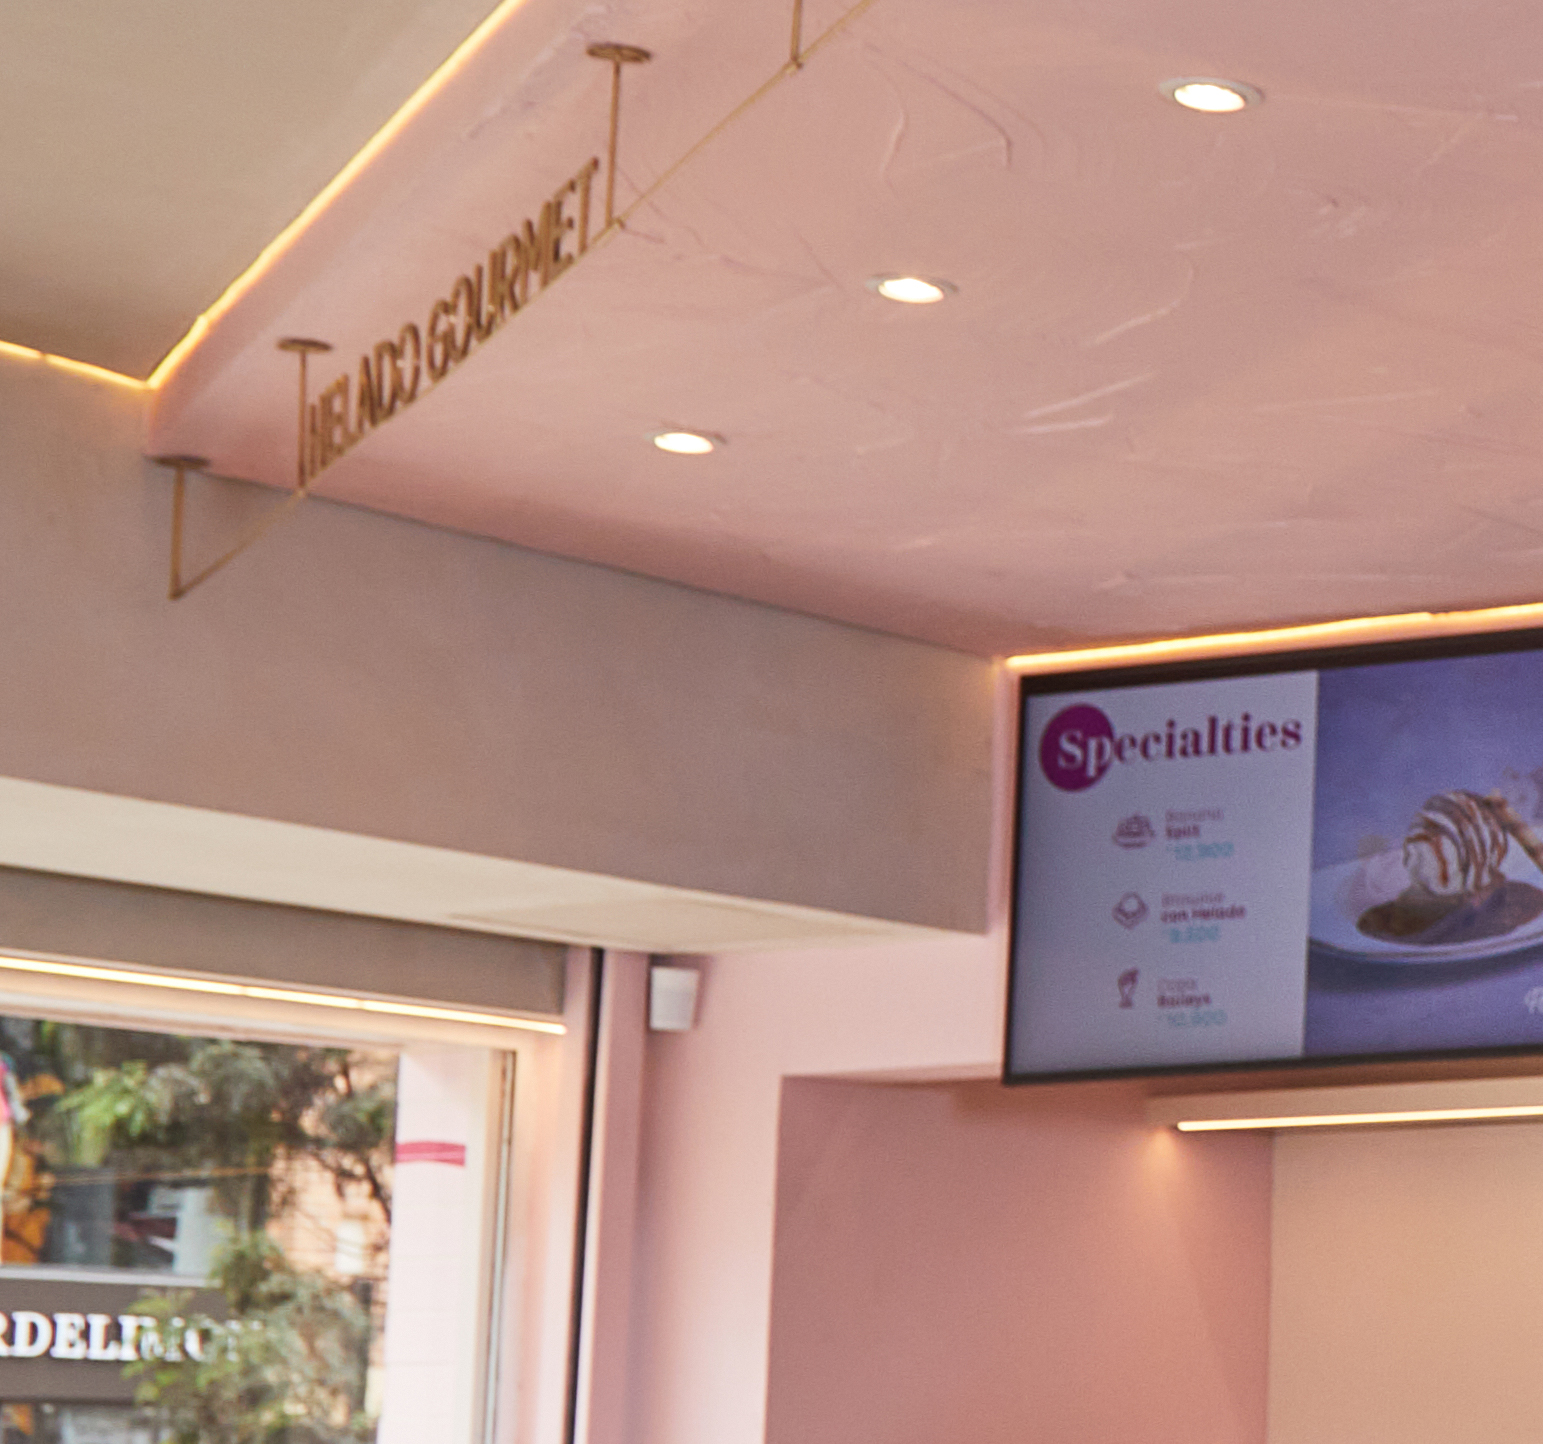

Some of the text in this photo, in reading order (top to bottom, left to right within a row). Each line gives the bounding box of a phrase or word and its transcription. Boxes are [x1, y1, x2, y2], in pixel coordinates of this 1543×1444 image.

[308, 156, 599, 478] HELADO GOURMET
[1057, 711, 1303, 778] Specialties
